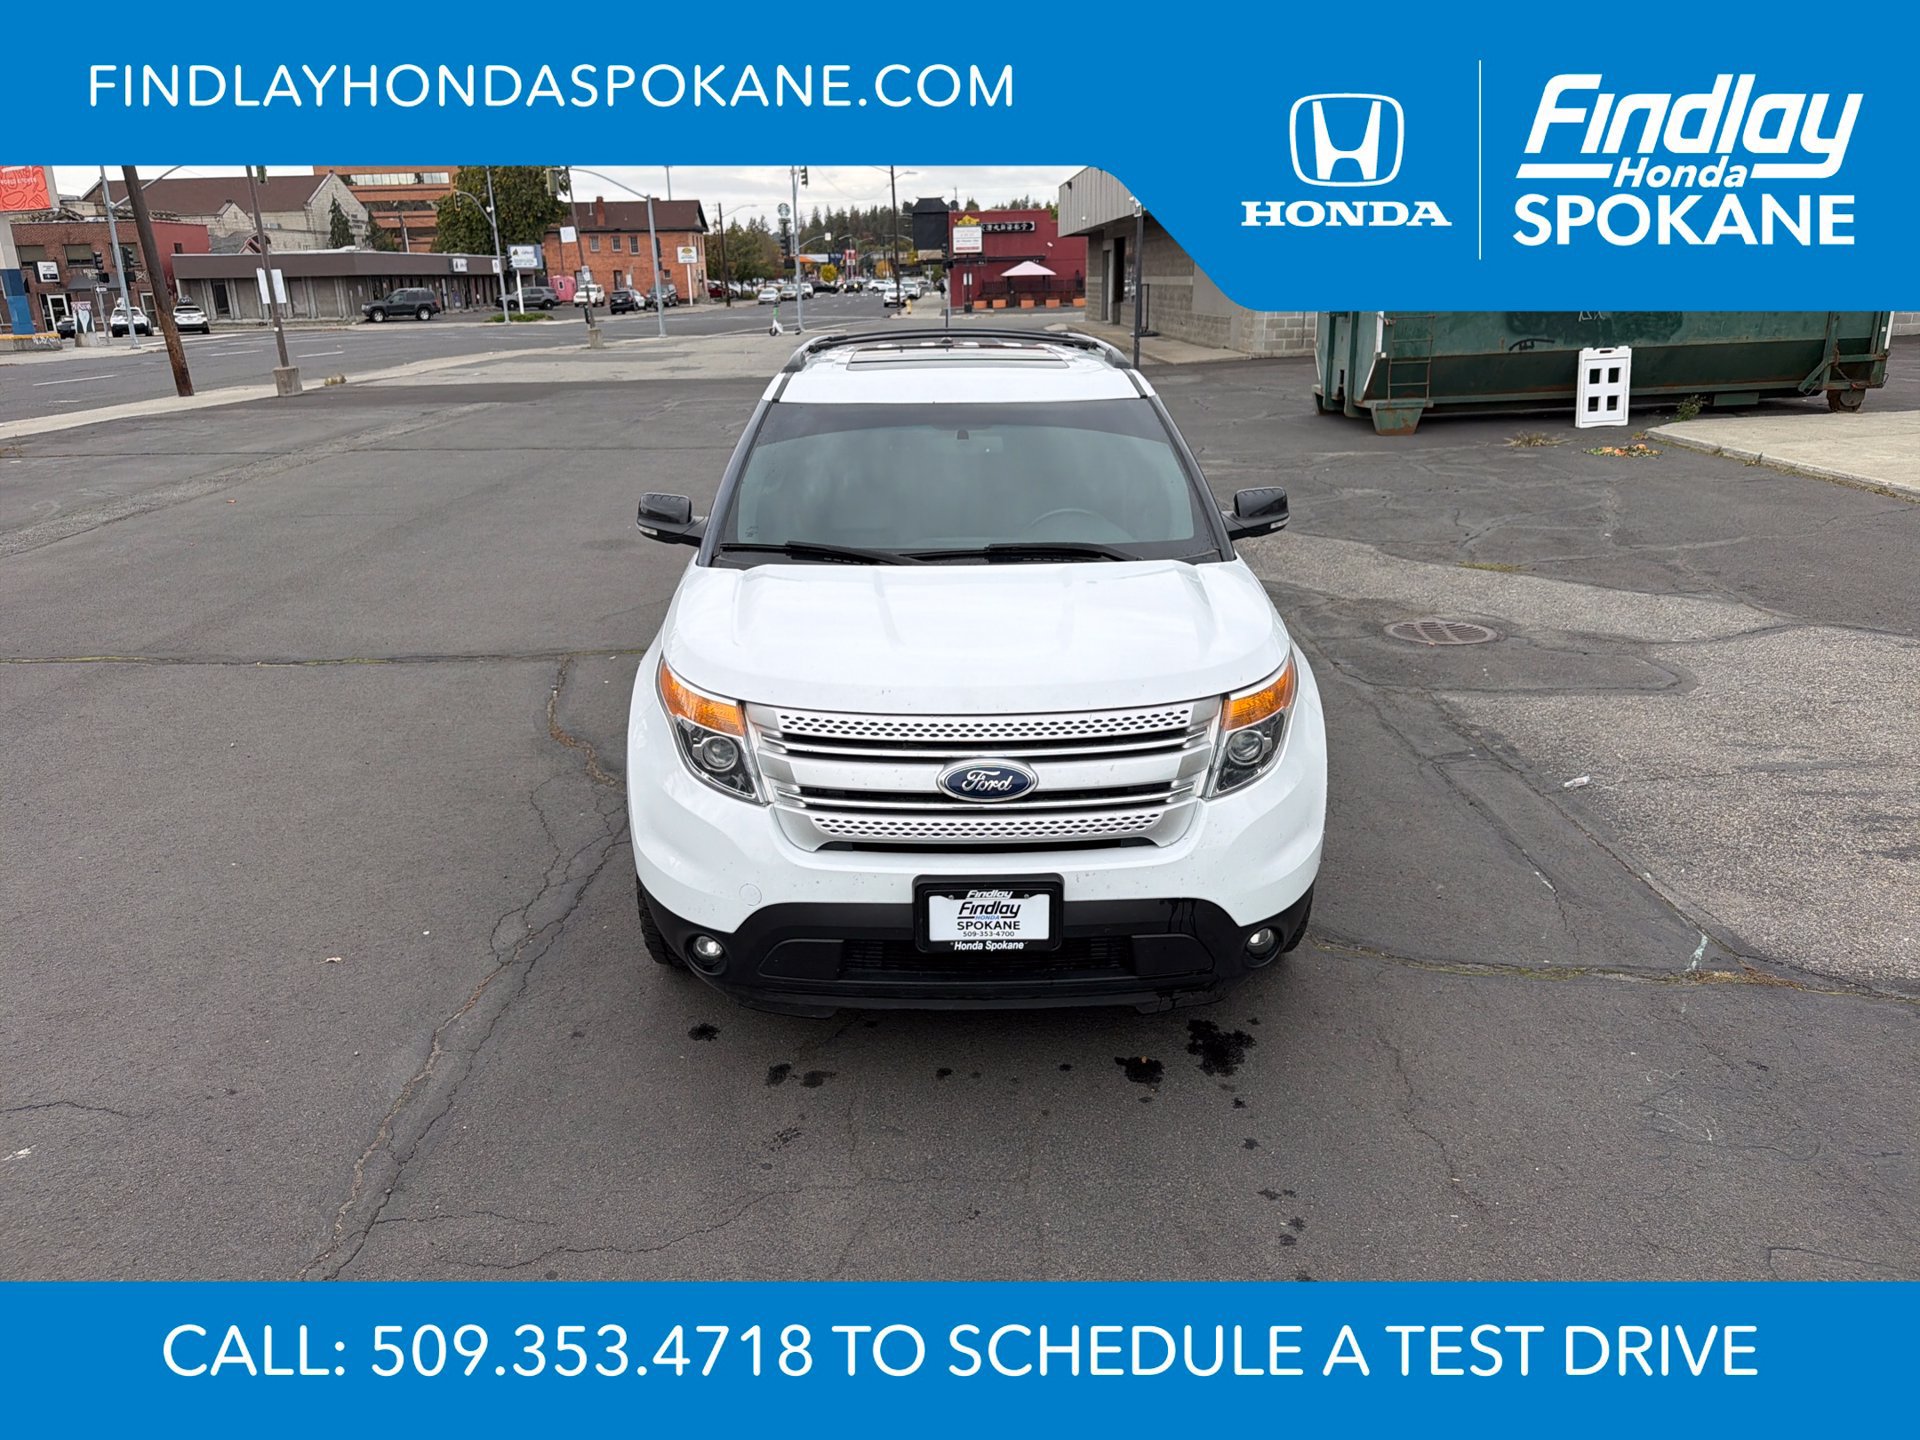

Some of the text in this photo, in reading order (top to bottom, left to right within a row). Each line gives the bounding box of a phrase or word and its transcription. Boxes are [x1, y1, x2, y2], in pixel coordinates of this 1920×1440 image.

[961, 769, 1014, 792] Ford
[966, 889, 1014, 899] Findlay
[958, 901, 1022, 918] Findlay
[957, 921, 1021, 931] SPOKANE
[954, 940, 1025, 952] Honda Spokane
